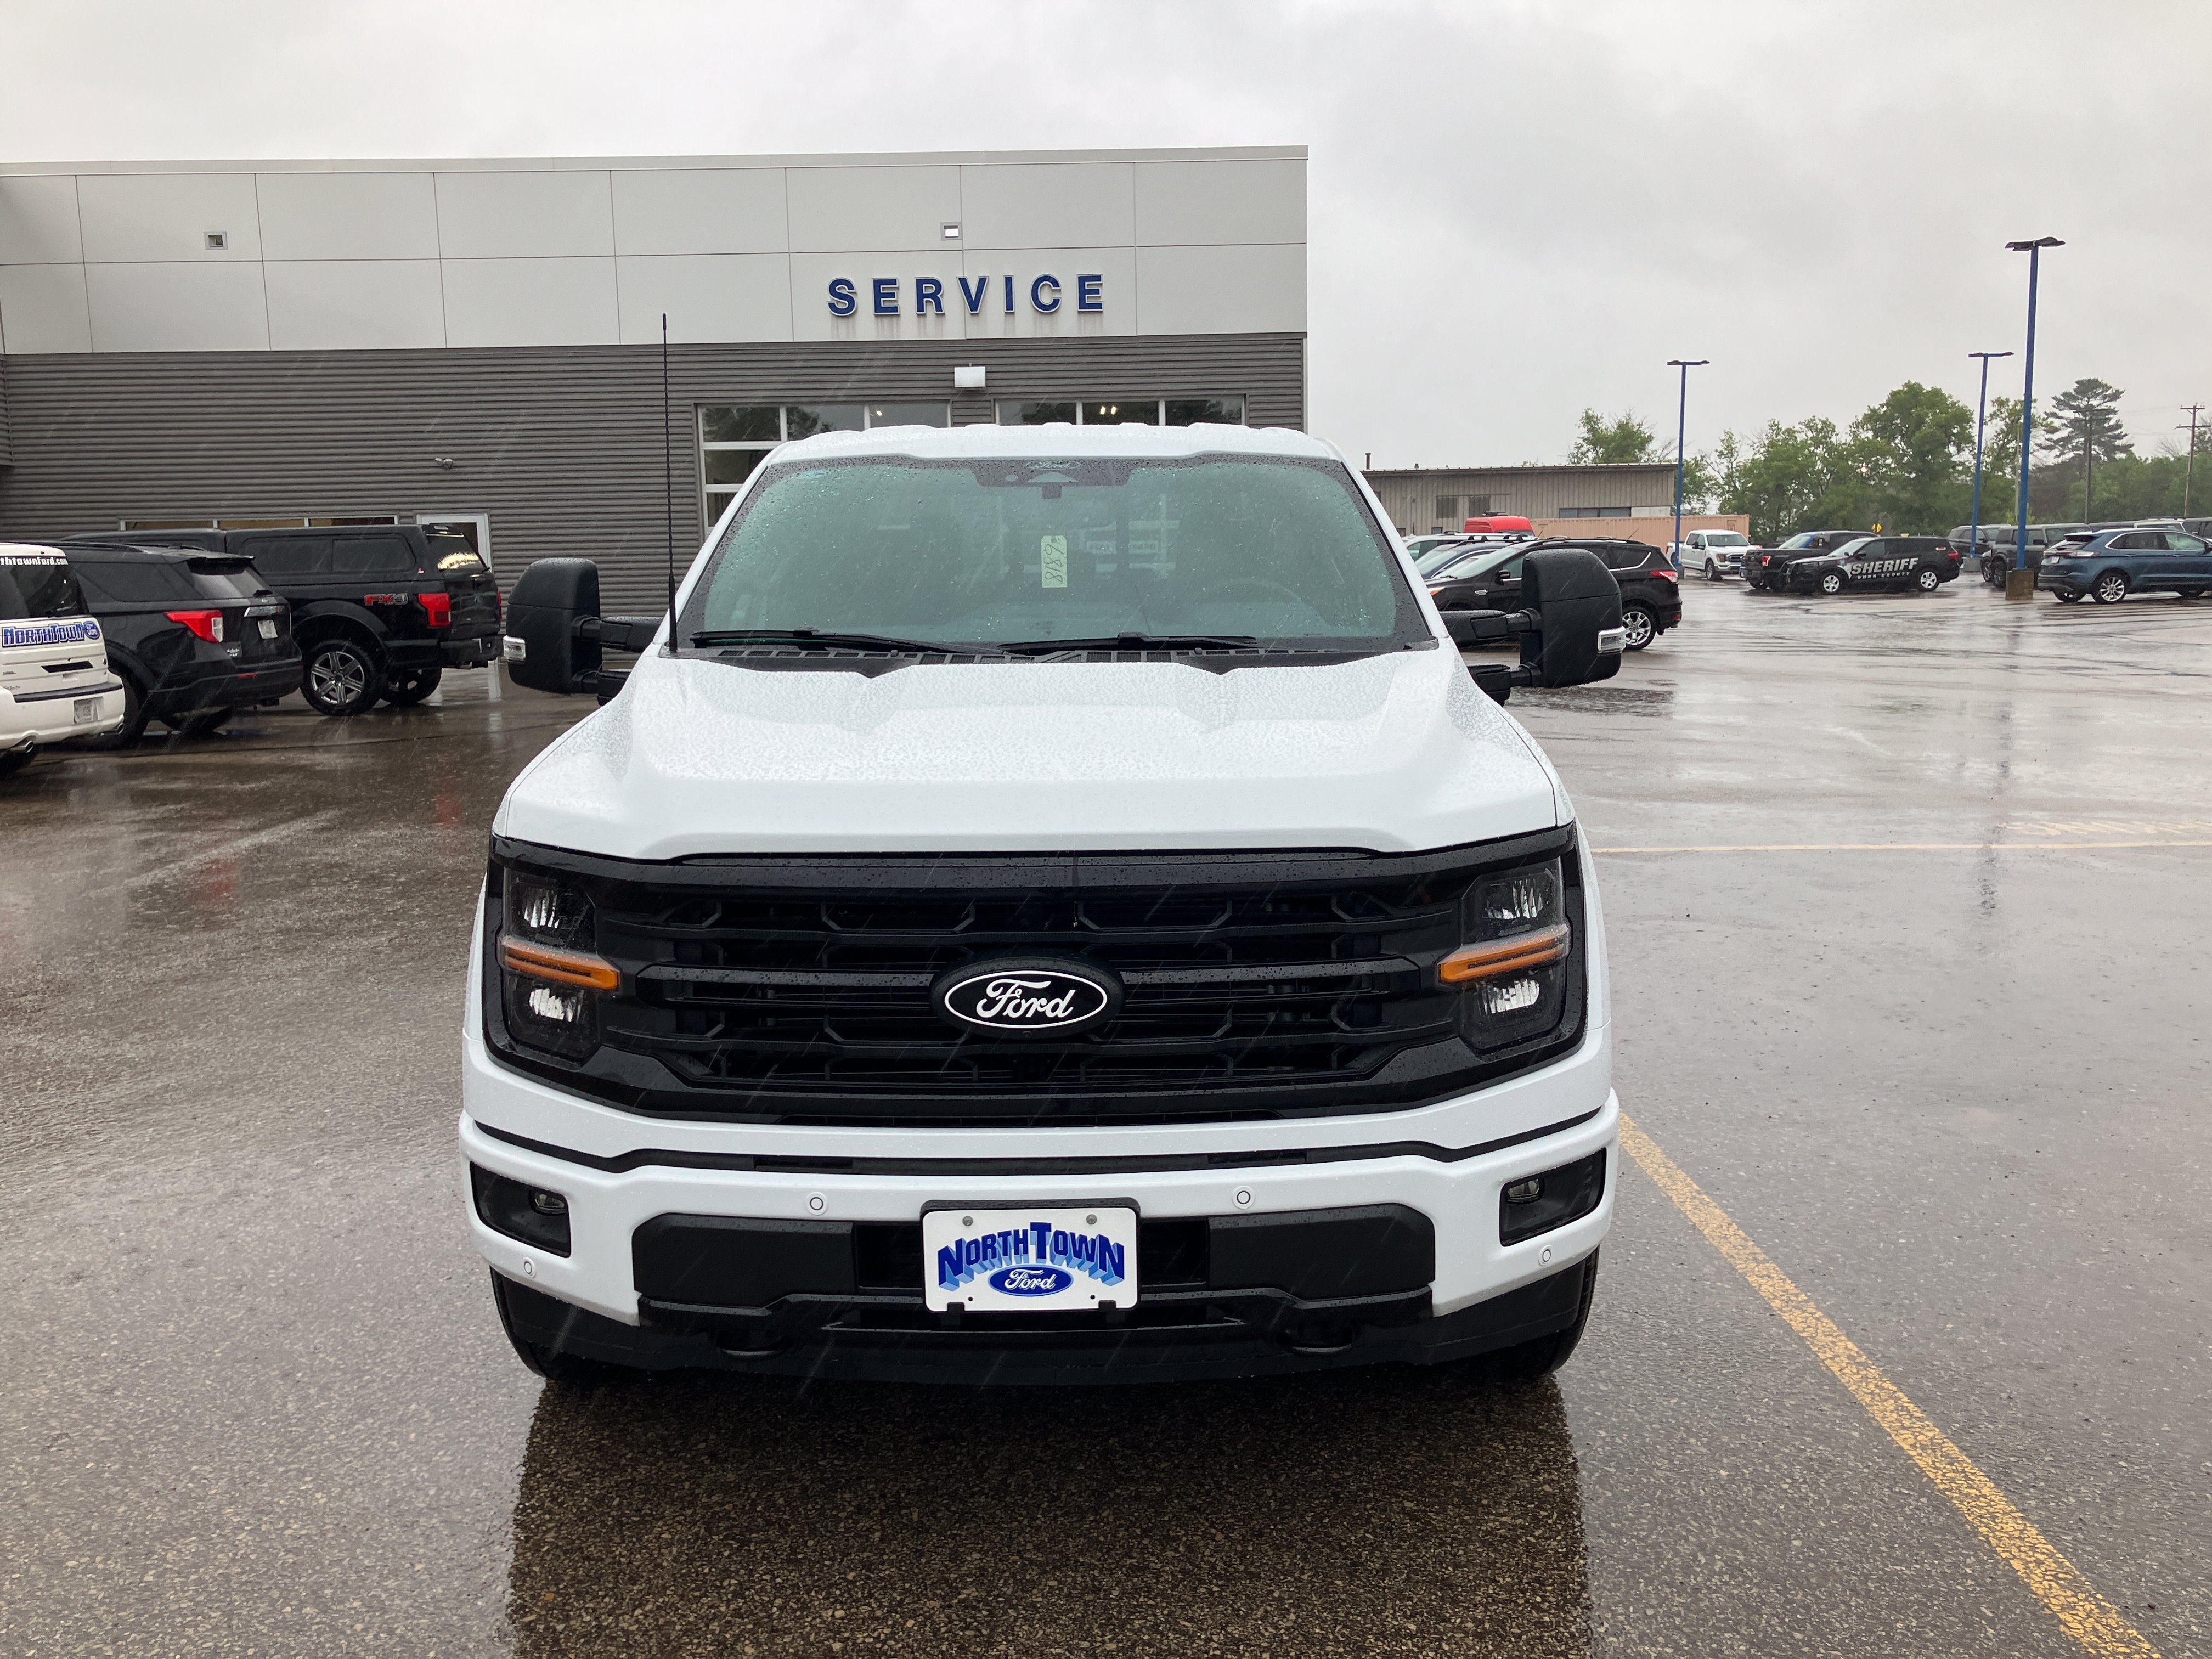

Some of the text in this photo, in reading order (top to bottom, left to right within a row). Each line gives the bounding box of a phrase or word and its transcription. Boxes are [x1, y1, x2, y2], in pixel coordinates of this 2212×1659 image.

[827, 274, 1104, 317] SERVICE
[0, 556, 69, 566] thtownford.c
[1851, 557, 1918, 575] SHERIFF
[364, 593, 408, 606] FX4
[976, 979, 1076, 1018] Ford
[1004, 1269, 1057, 1290] Ford
